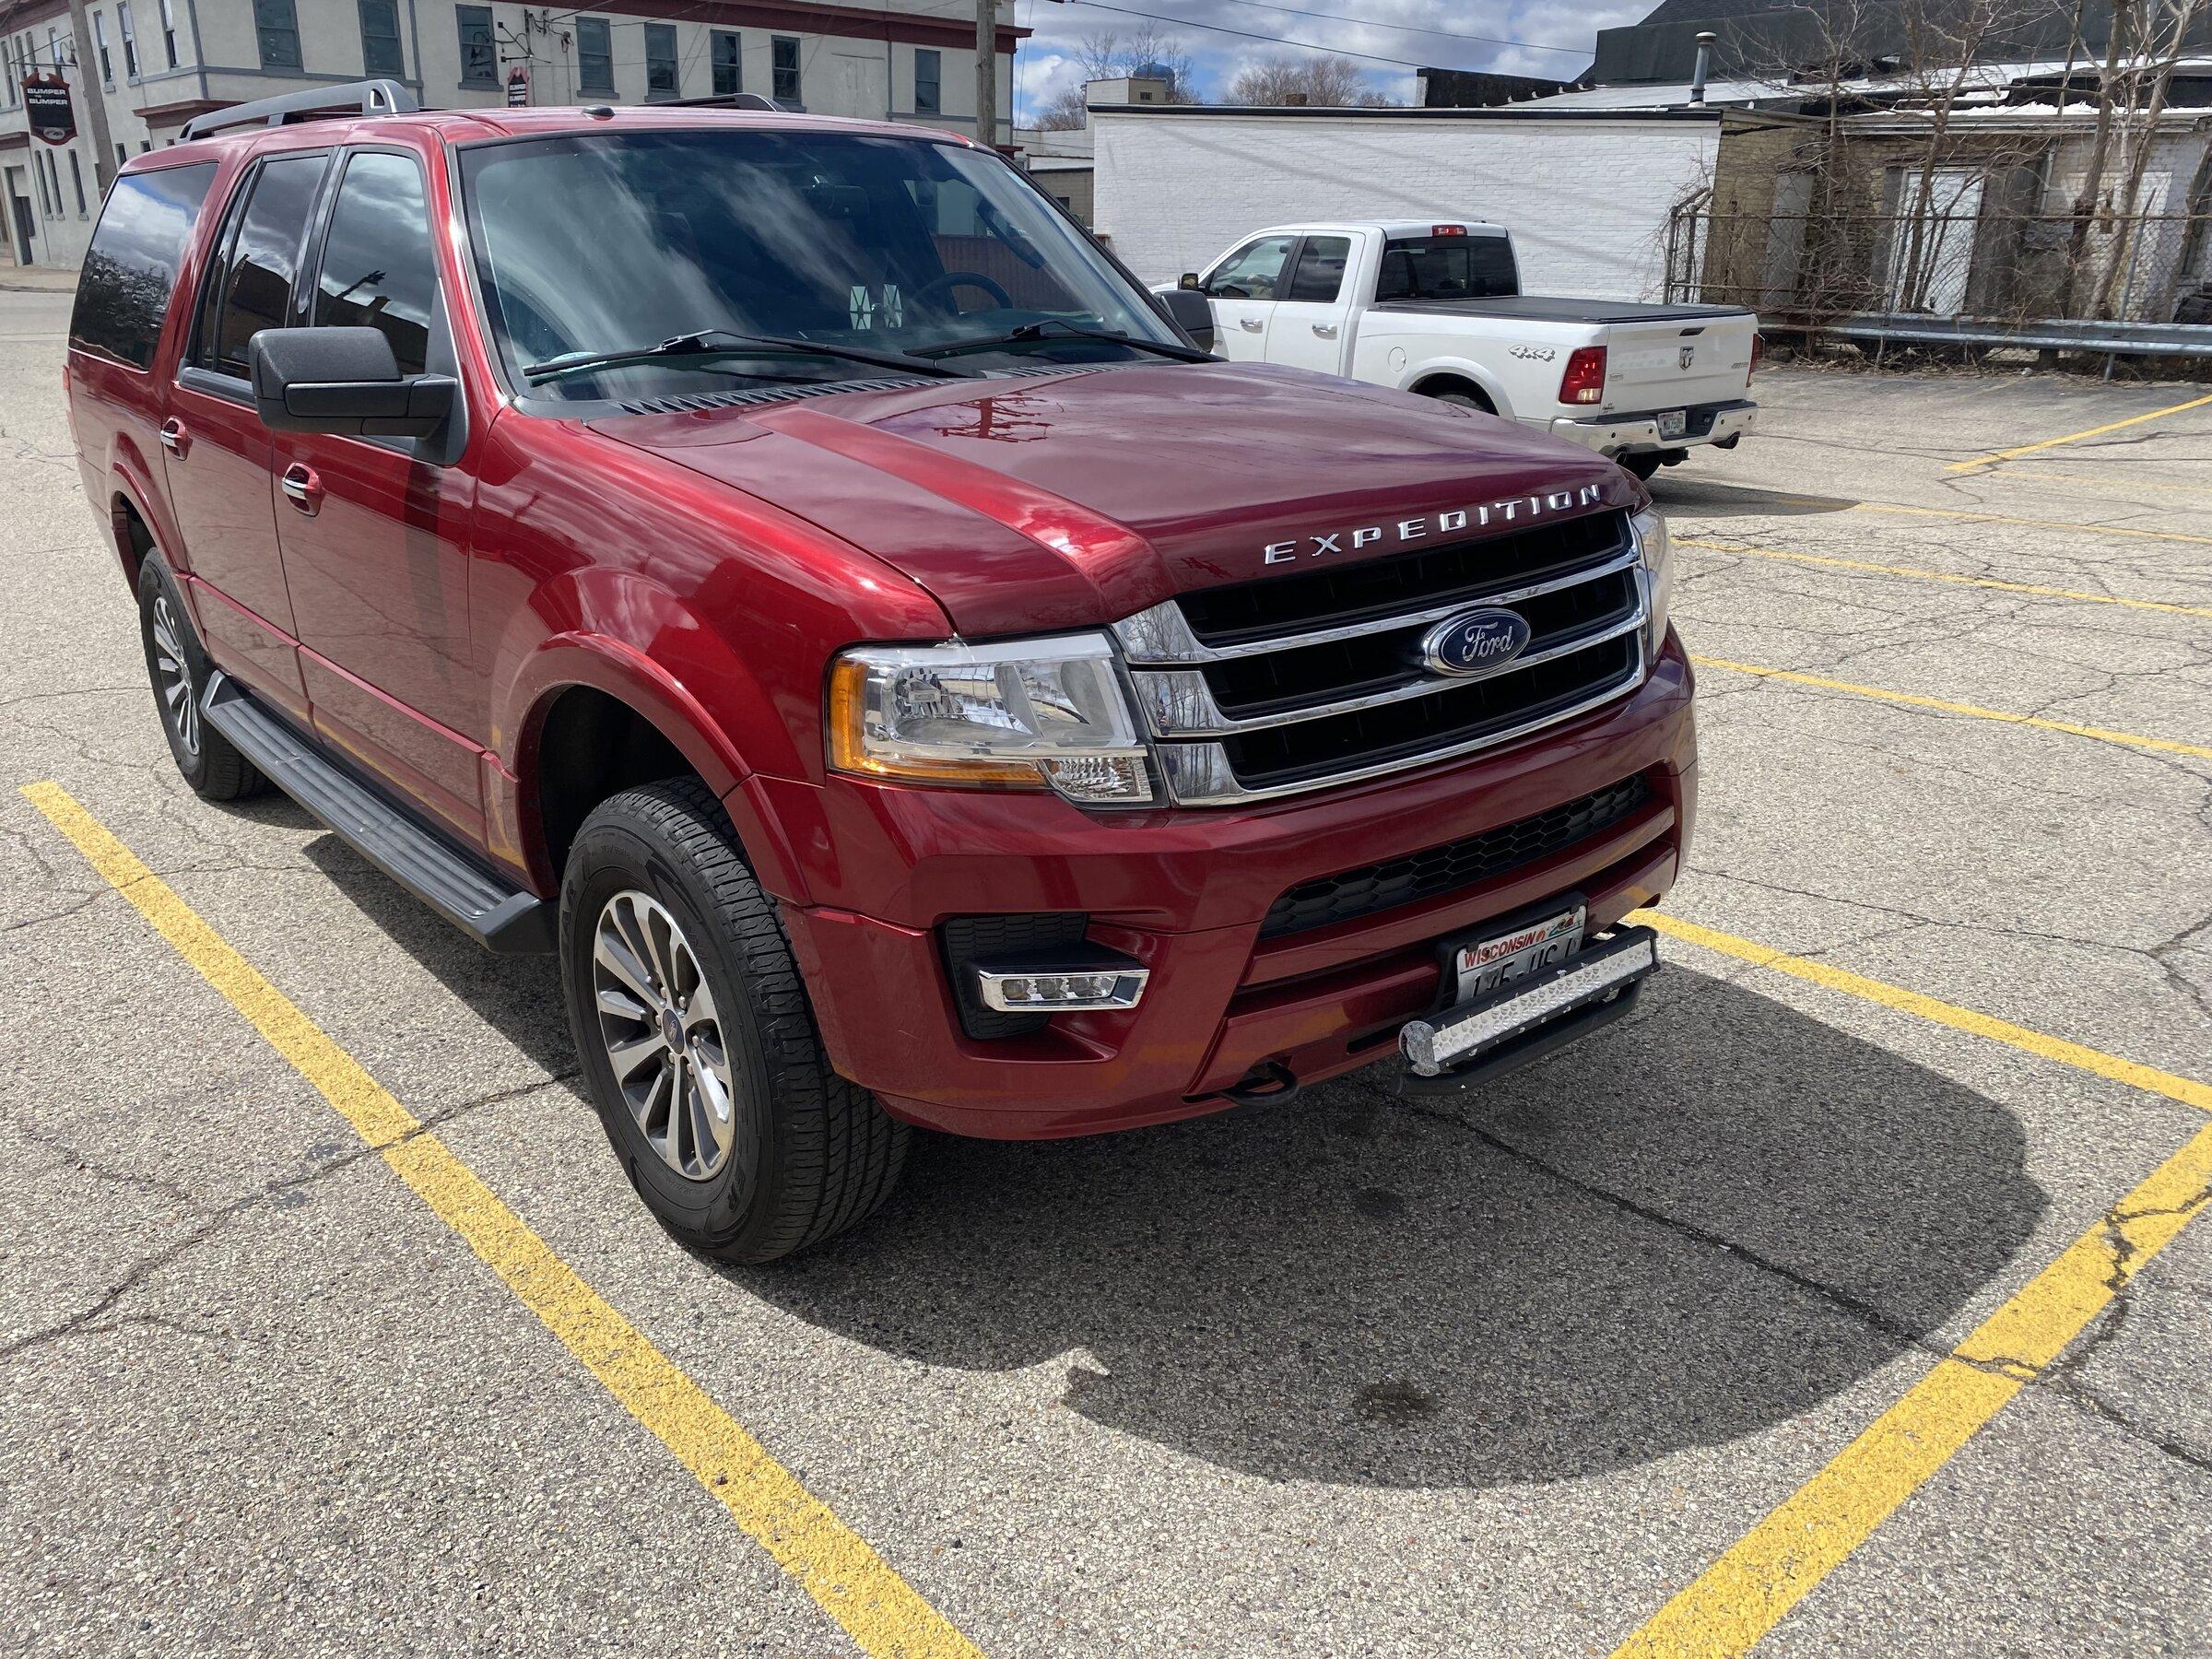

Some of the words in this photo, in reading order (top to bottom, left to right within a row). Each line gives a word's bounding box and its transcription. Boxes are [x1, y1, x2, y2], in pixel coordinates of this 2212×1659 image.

[1264, 483, 1602, 565] EXPEDITION
[1462, 622, 1515, 662] Ford
[1464, 930, 1537, 969] WISCONSIN
